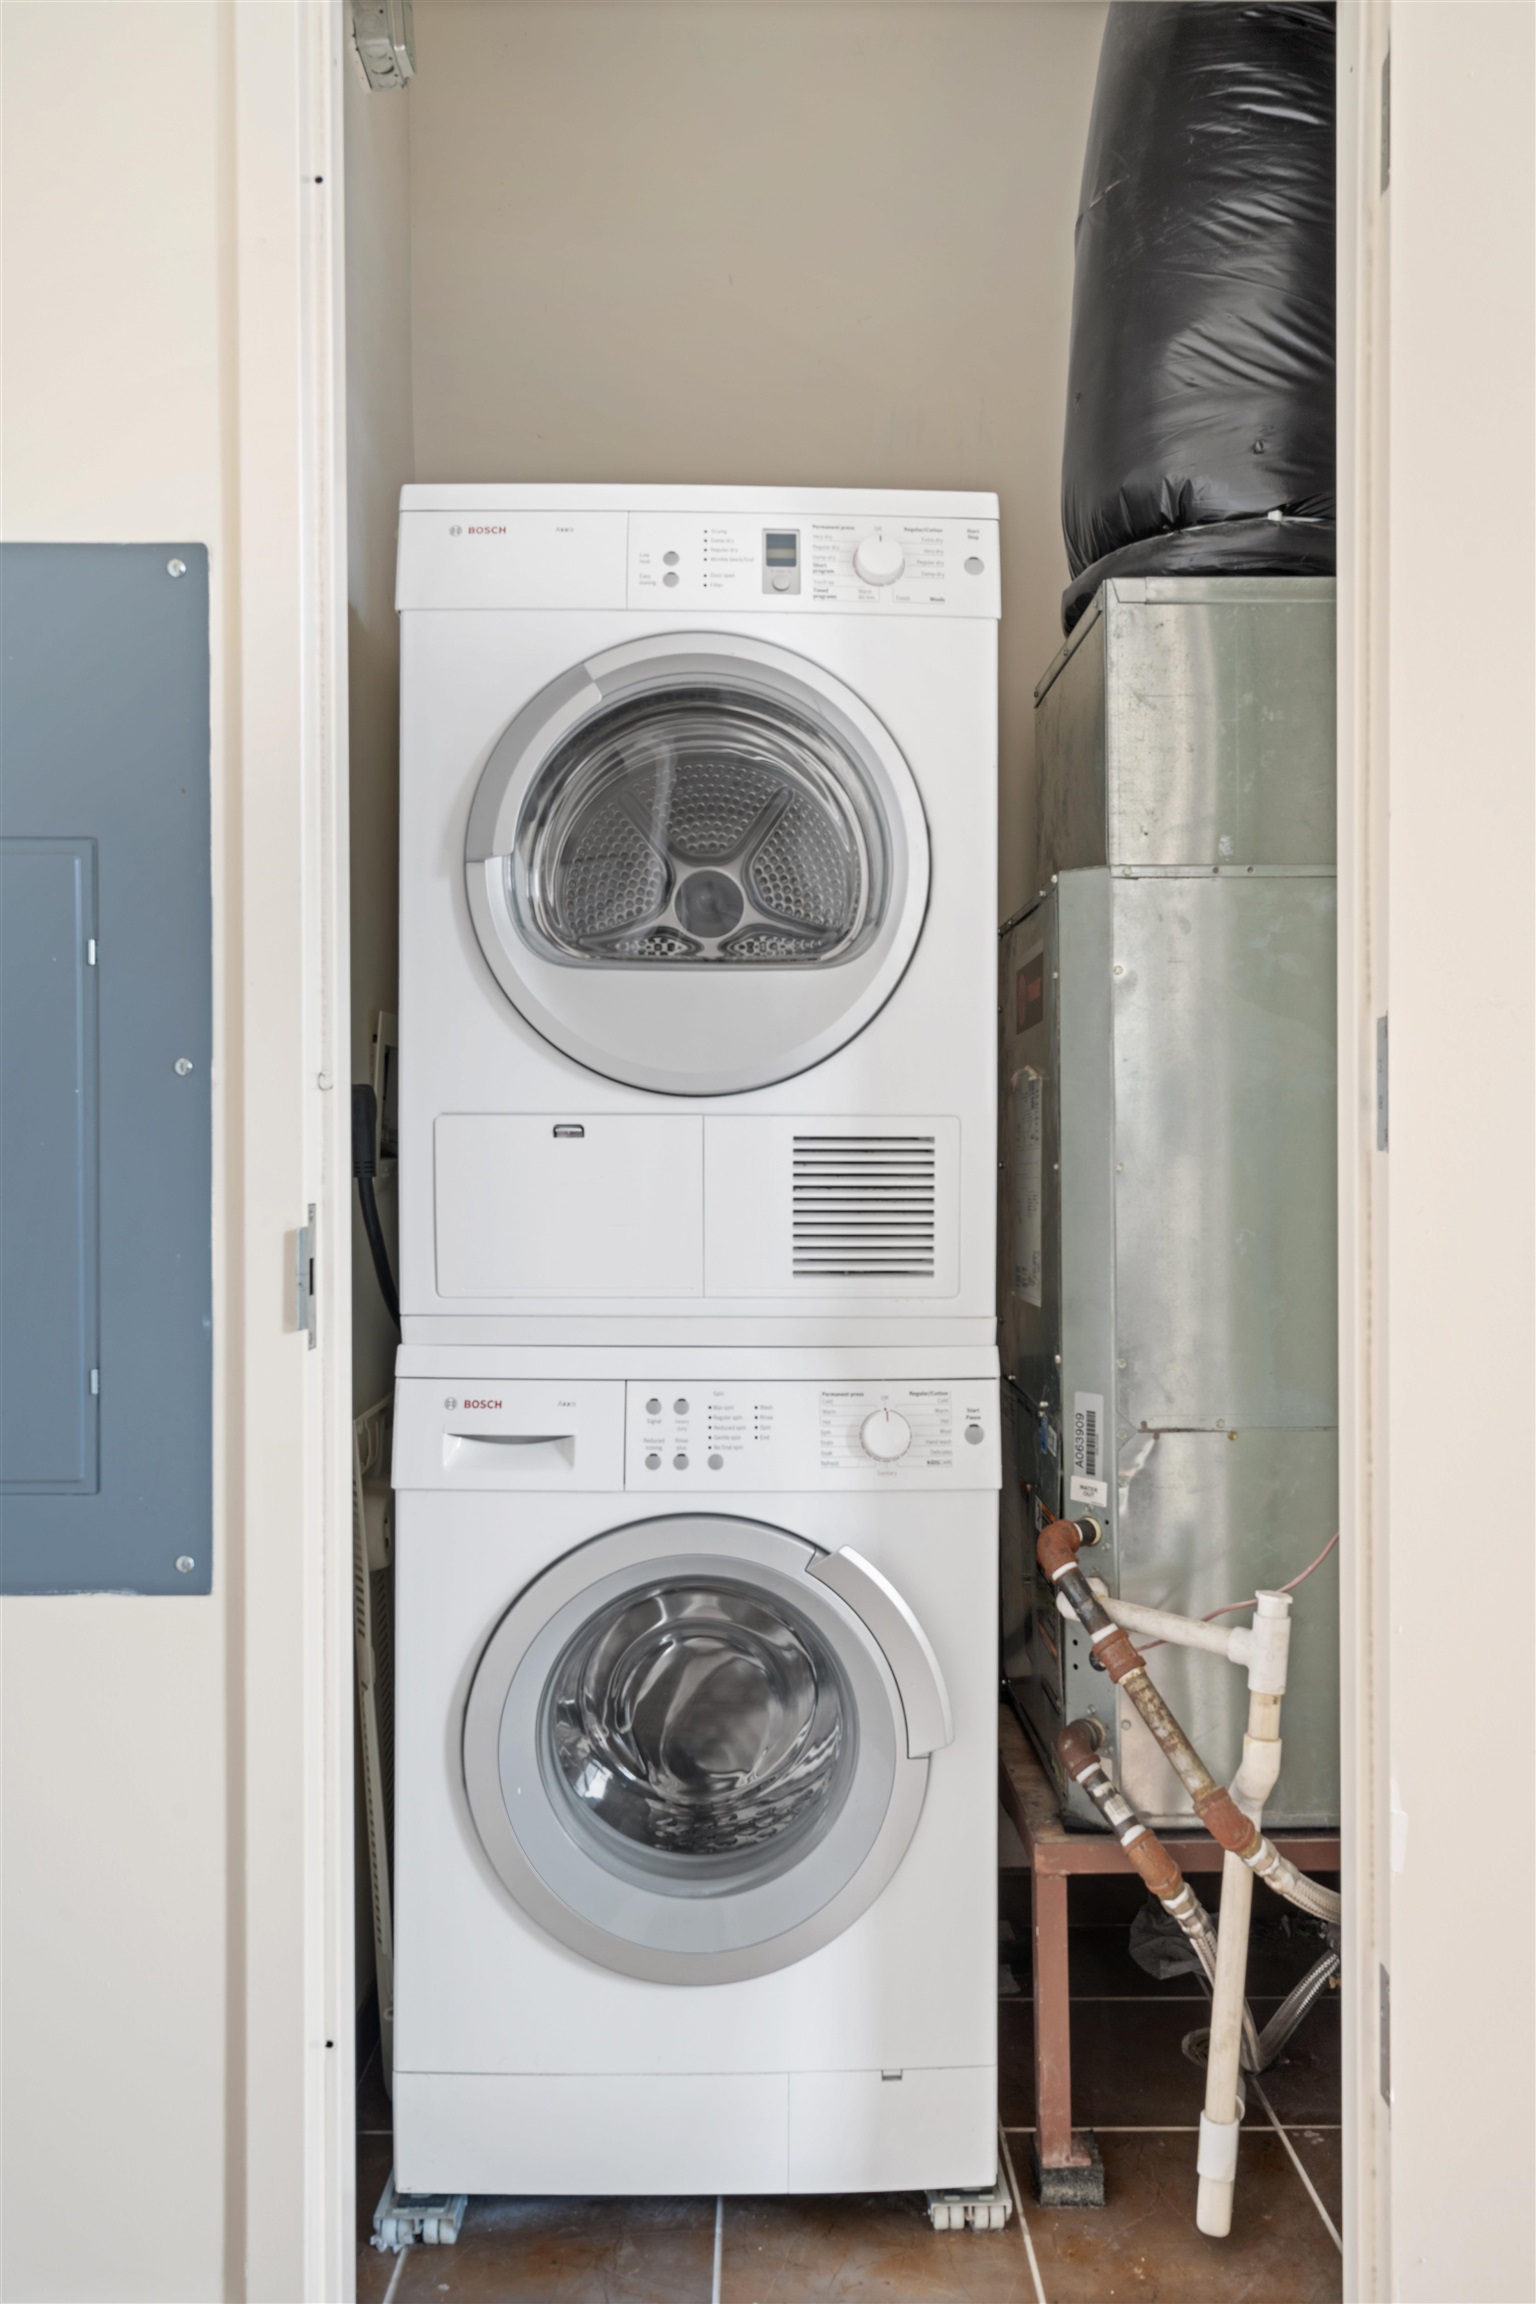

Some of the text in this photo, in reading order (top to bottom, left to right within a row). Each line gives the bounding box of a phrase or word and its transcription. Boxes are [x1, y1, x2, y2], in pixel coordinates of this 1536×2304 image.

[468, 526, 507, 535] BOSCH
[463, 1399, 503, 1409] BOSCH
[1075, 1412, 1085, 1469] A063909
[1079, 1484, 1098, 1493] WATER
